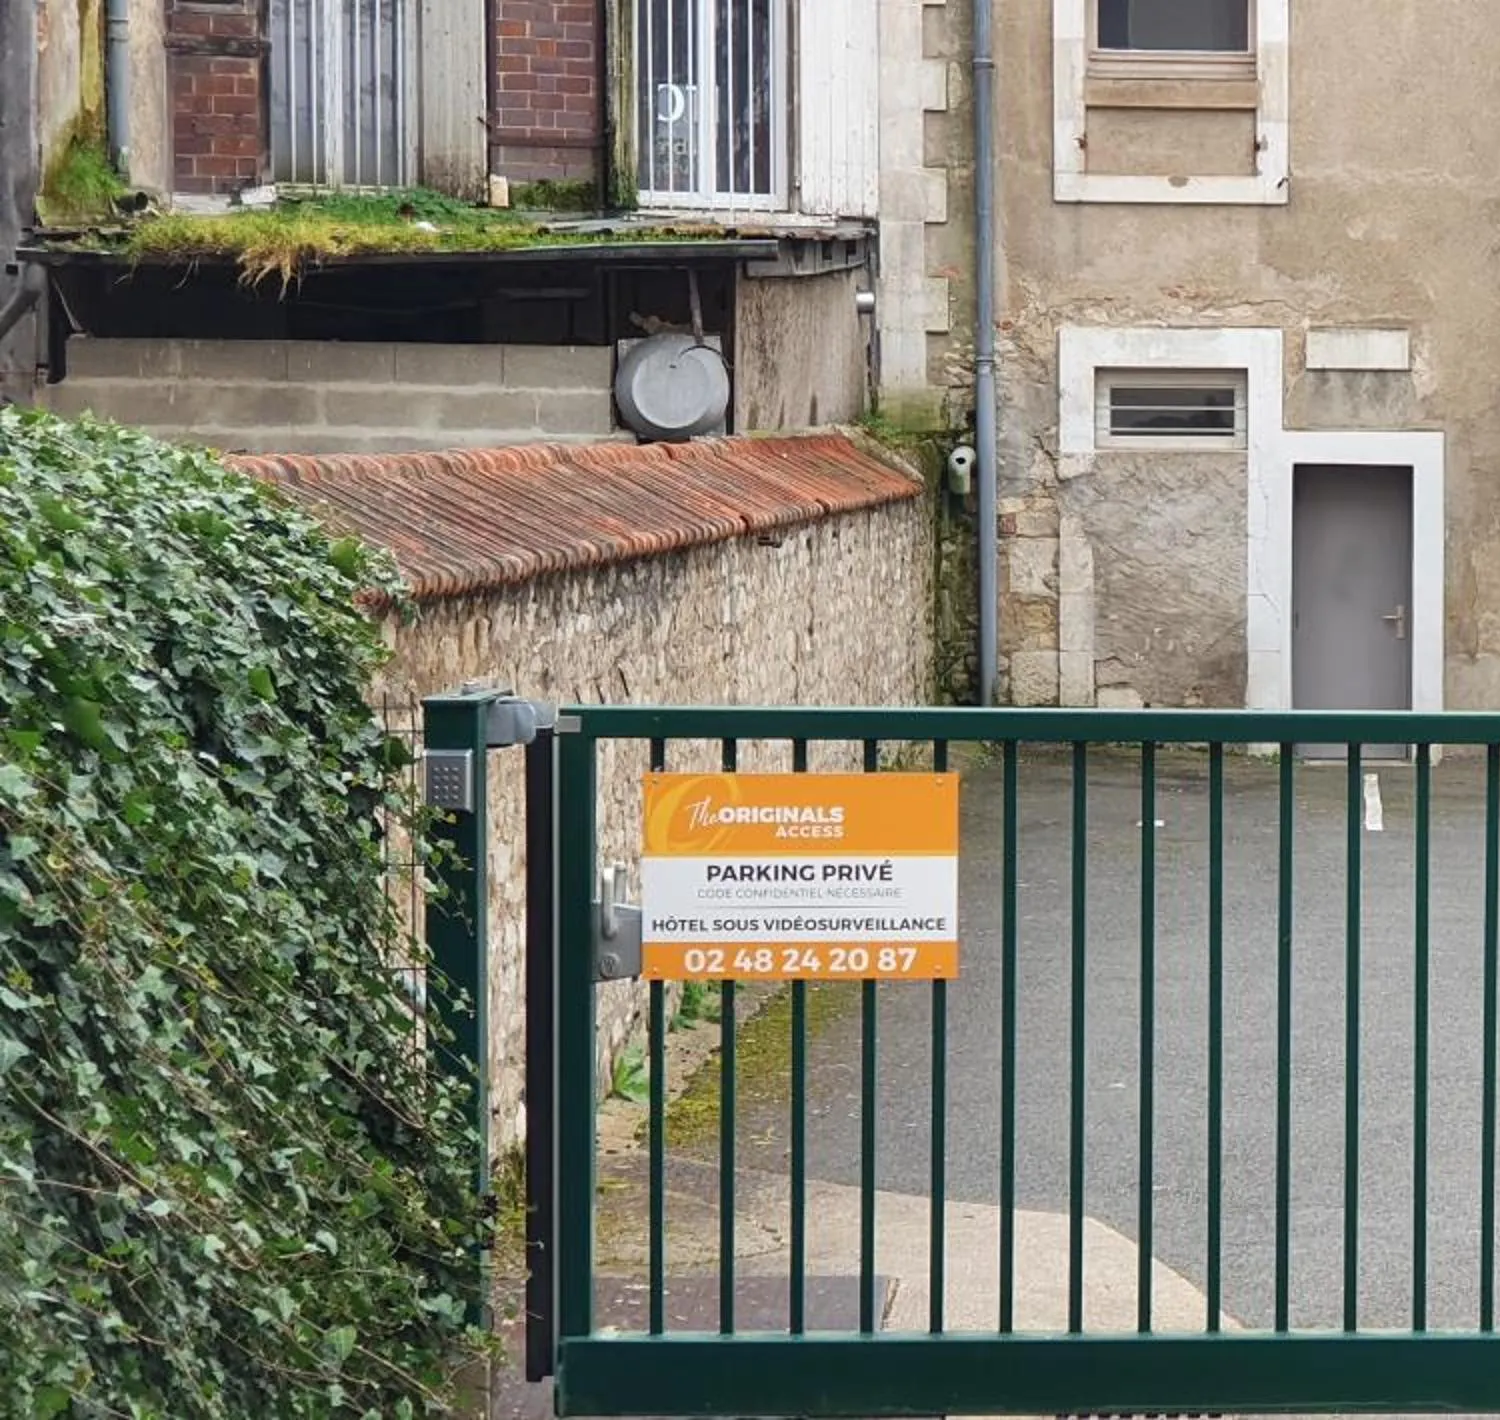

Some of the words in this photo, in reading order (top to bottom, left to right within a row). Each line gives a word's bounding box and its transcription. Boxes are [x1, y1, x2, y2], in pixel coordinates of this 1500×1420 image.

[718, 806, 844, 824] ORIGINALS
[775, 825, 844, 838] ACCESS
[706, 865, 815, 881] PARKING
[822, 859, 893, 881] PRIVÉ
[697, 888, 733, 899] CODE
[735, 888, 823, 899] CONFIDENTIEL
[652, 915, 709, 932] HÔTEL
[712, 919, 759, 931] SOUS
[764, 915, 946, 931] VIDÉOSURVEILLANCE
[684, 949, 725, 973] 02
[733, 949, 773, 973] 48
[781, 949, 821, 972] 24
[829, 949, 870, 972] 20
[877, 948, 918, 972] 87
